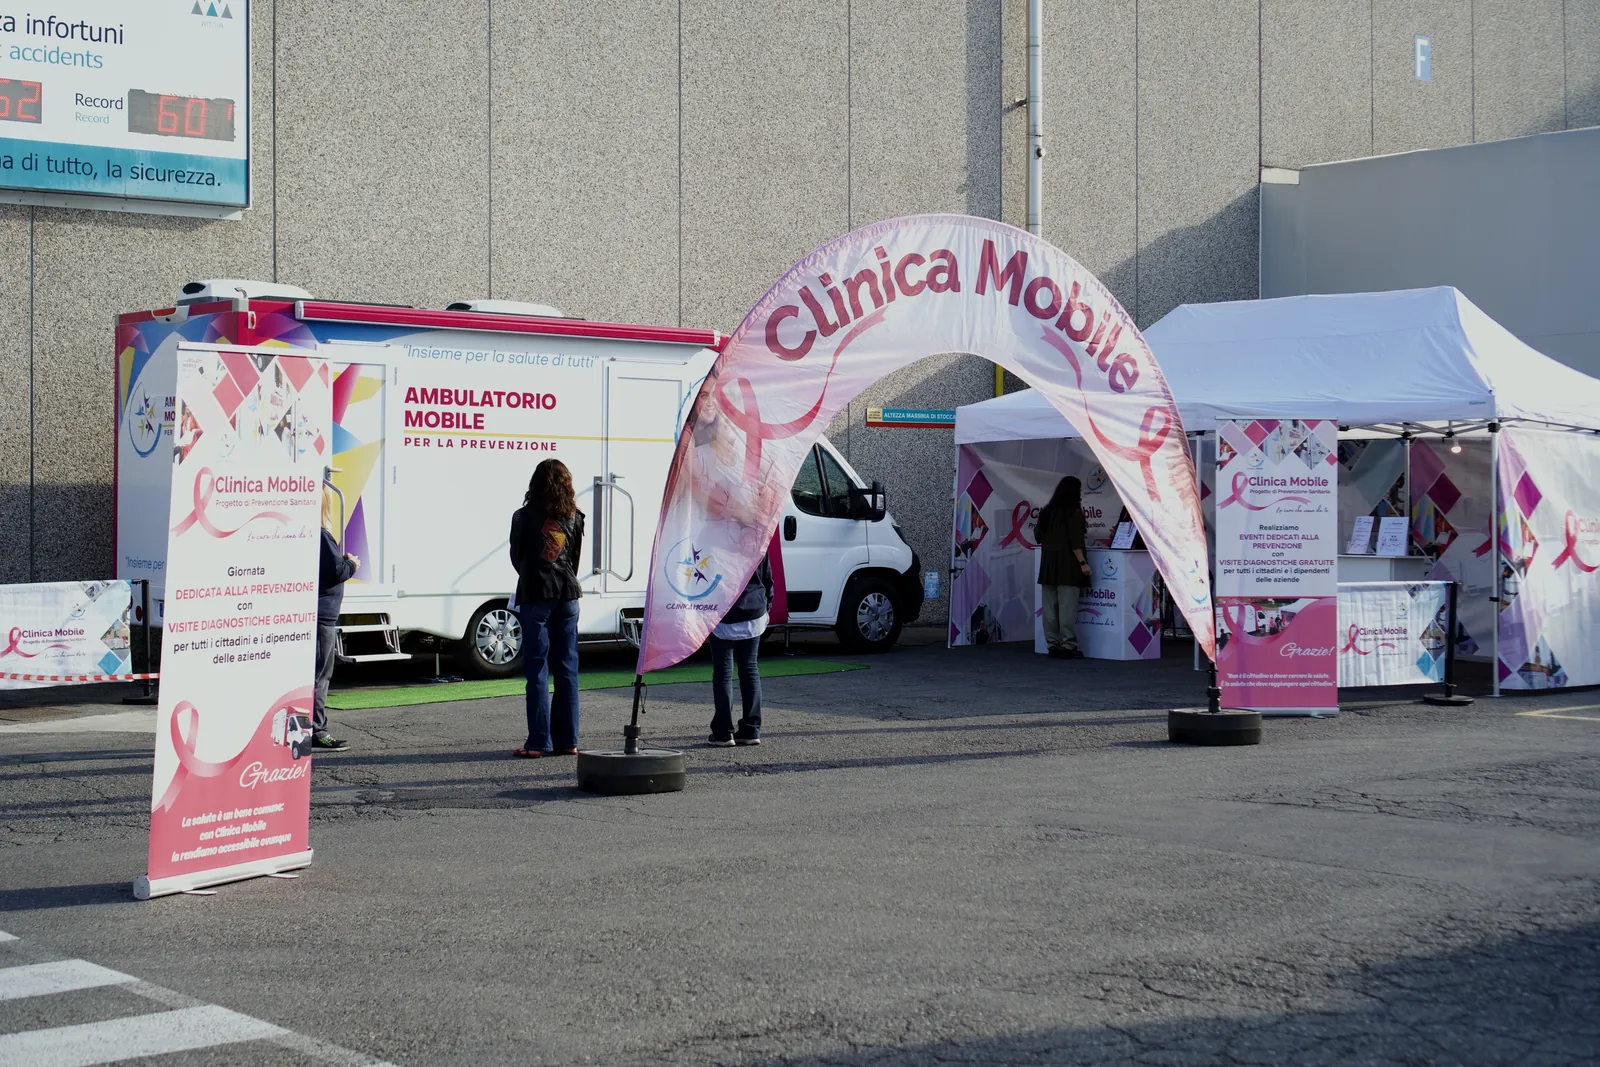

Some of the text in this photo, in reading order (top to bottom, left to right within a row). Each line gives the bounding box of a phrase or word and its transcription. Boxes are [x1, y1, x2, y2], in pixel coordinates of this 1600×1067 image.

[0, 13, 124, 44] a infortuni
[9, 45, 103, 68] accidents
[1416, 38, 1428, 77] F
[75, 93, 124, 110] Record
[75, 112, 110, 124] Record
[0, 152, 221, 186] a di tutto, la sicurezza.
[764, 238, 1140, 394] Clinica Mobile
[465, 350, 489, 364] per
[492, 350, 504, 363] la
[508, 352, 549, 366] salute
[552, 353, 565, 366] di
[404, 386, 557, 410] AMBULATORIO
[404, 410, 485, 430] MOBILE
[404, 437, 557, 452] PER LA PREVENZIONE
[215, 476, 316, 494] Clinica Mobile
[1248, 476, 1328, 487] Clinica Mobile
[216, 499, 243, 508] Progetto
[244, 499, 250, 507] di
[252, 498, 288, 506] Prevenzione
[152, 560, 164, 572] per
[227, 566, 266, 577] Giornata
[175, 581, 314, 600] DEDICATA ALLA PREVENZIONE
[1086, 588, 1116, 600] Mobile
[237, 602, 253, 610] con
[168, 612, 316, 634] VISITE DIAGNOSTICHE GRATUITE
[1360, 627, 1408, 636] Clinica Mobile
[22, 628, 84, 638] Clinica Mobile
[173, 642, 188, 654] per
[191, 638, 209, 650] tutti
[214, 634, 251, 648] cittadini
[252, 636, 258, 644] e
[265, 630, 312, 646] dipendenti
[212, 650, 272, 664] delle aziende
[1280, 642, 1335, 659] Grazie!
[239, 760, 310, 790] Grazie!
[182, 816, 192, 828] La
[192, 812, 216, 826] salute
[217, 810, 222, 822] è
[222, 810, 234, 820] un
[234, 808, 252, 819] bene
[200, 820, 268, 841] con Clinica Mobile
[171, 832, 292, 863] la rendiamo accessibile ovunque
